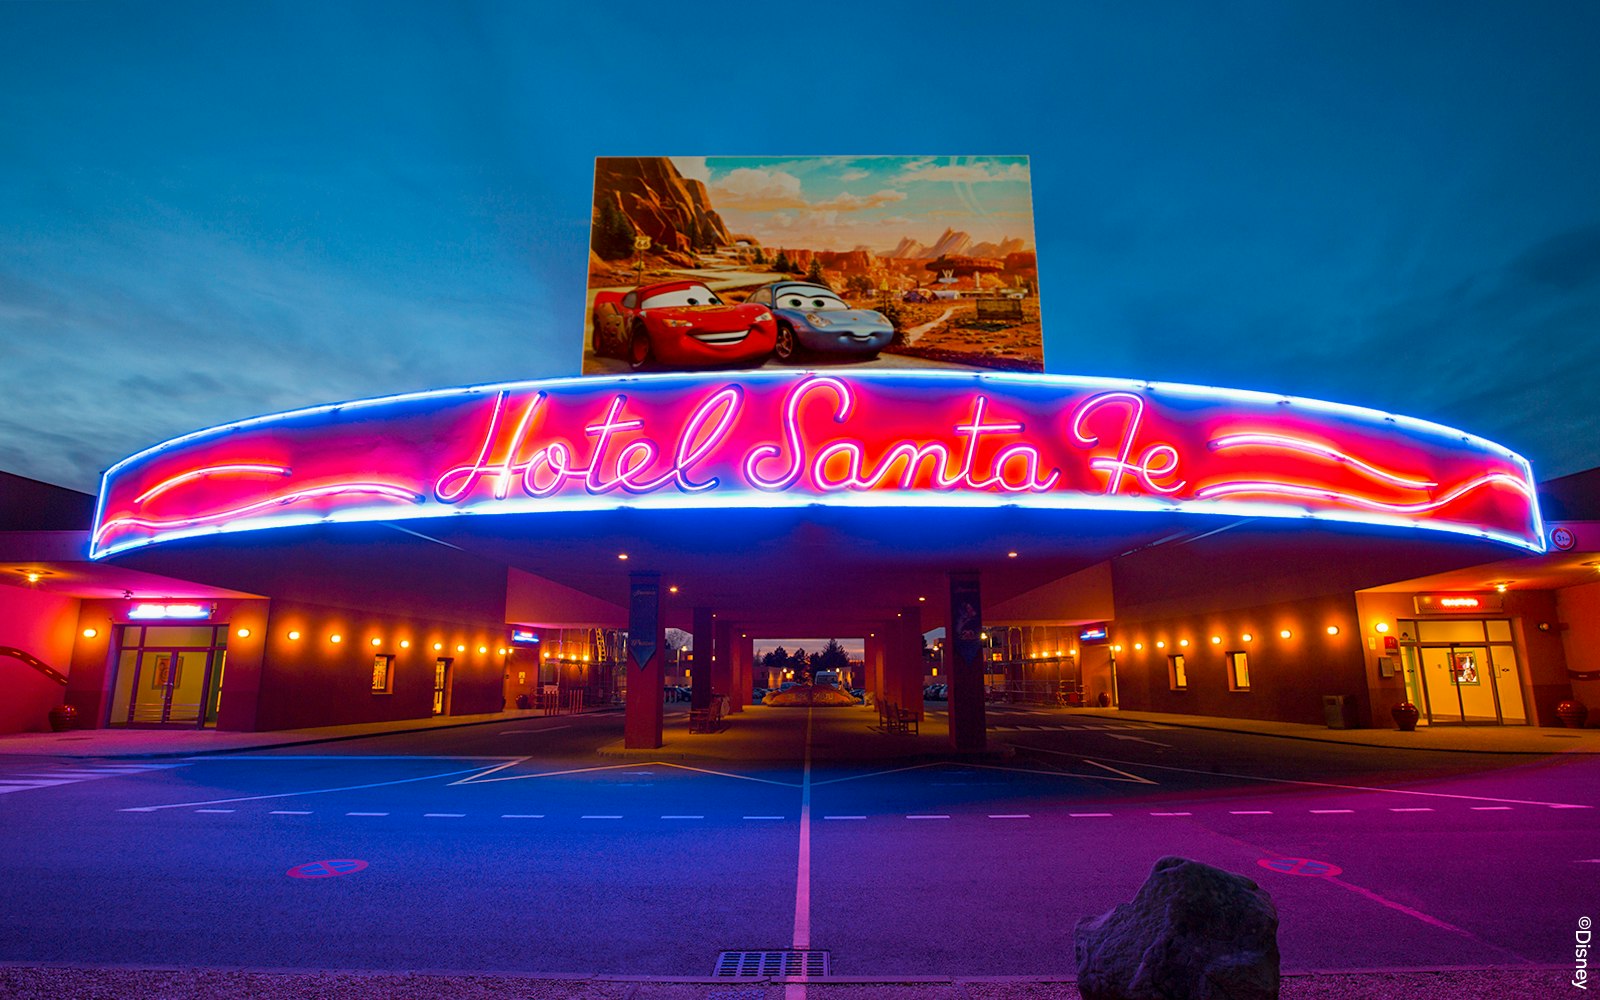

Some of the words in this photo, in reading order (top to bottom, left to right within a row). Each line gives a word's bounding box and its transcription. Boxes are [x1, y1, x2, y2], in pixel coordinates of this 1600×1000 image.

[434, 384, 741, 503] Hotel
[743, 375, 1061, 492] Santa
[1068, 390, 1187, 498] Fe
